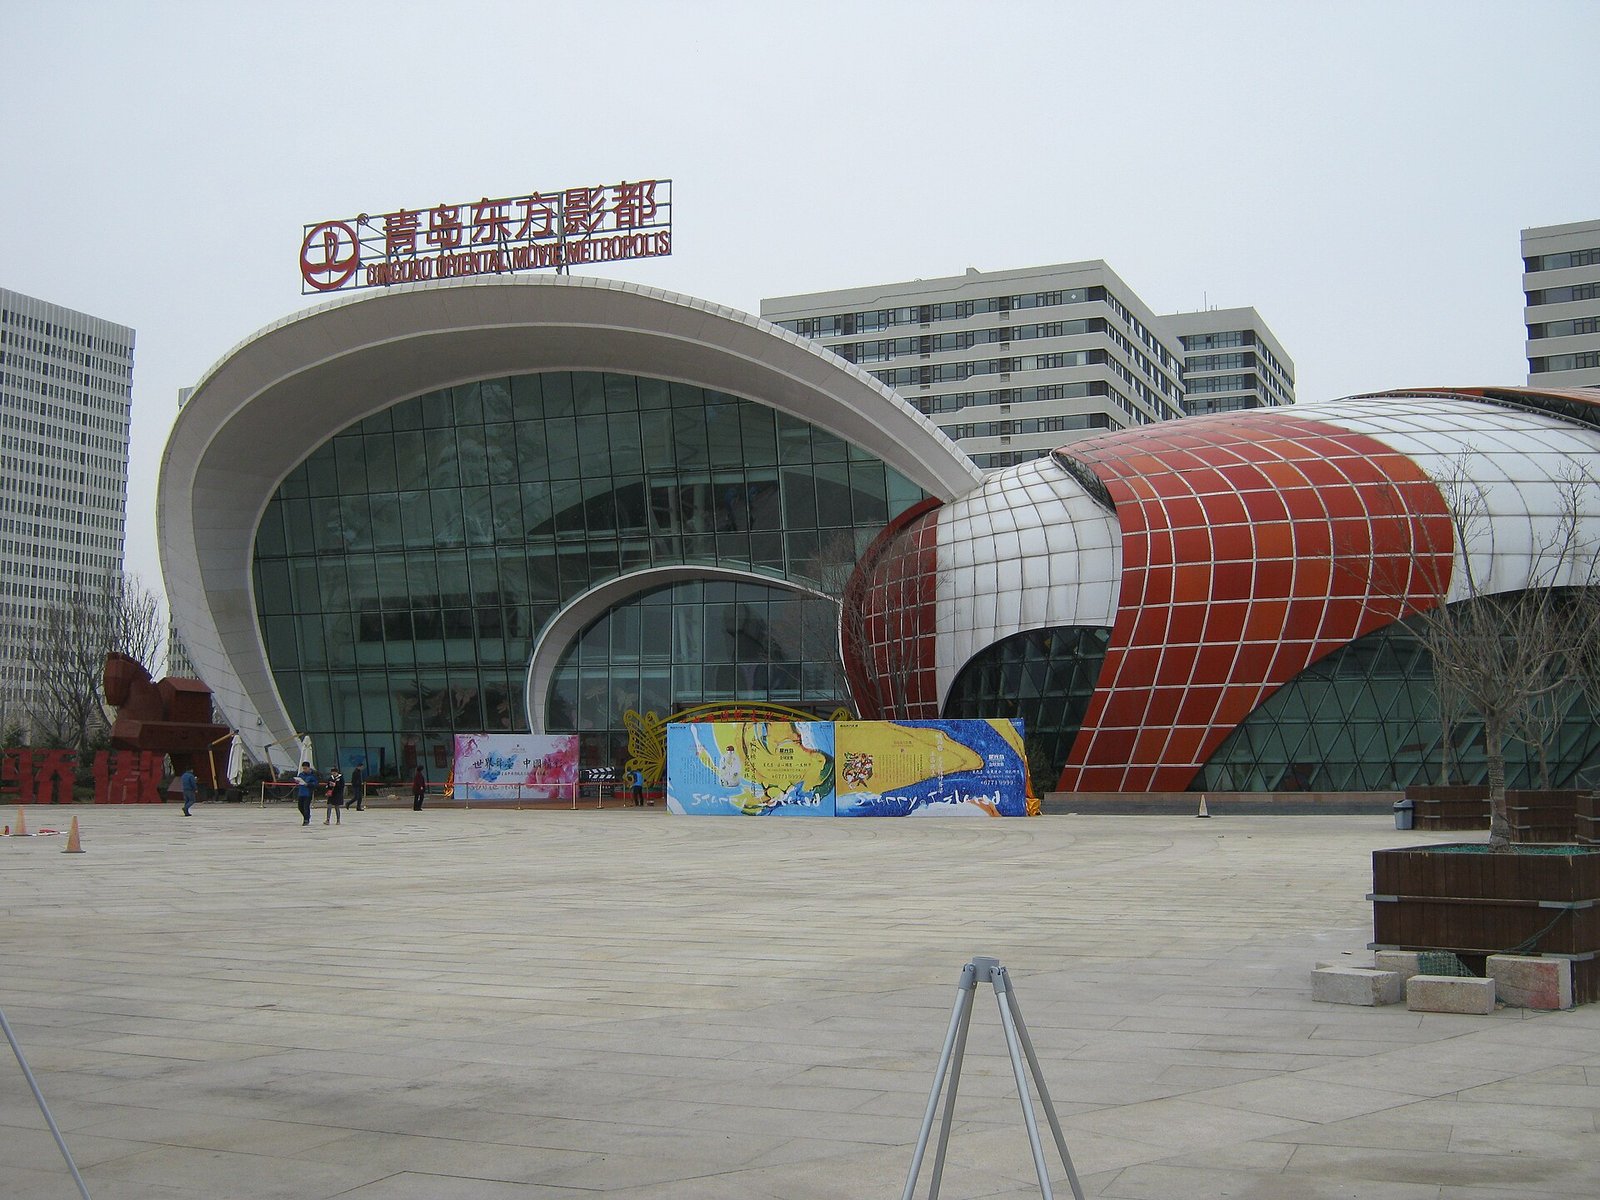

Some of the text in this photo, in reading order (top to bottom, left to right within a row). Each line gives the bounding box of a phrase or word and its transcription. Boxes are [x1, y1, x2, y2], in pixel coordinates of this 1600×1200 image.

[383, 180, 657, 254] 青岛东方影都
[367, 230, 671, 286] QINGDAO ORIENTAL MOVIE METROPOLIS
[1, 748, 164, 804] 骄傲
[928, 789, 1001, 806] Island
